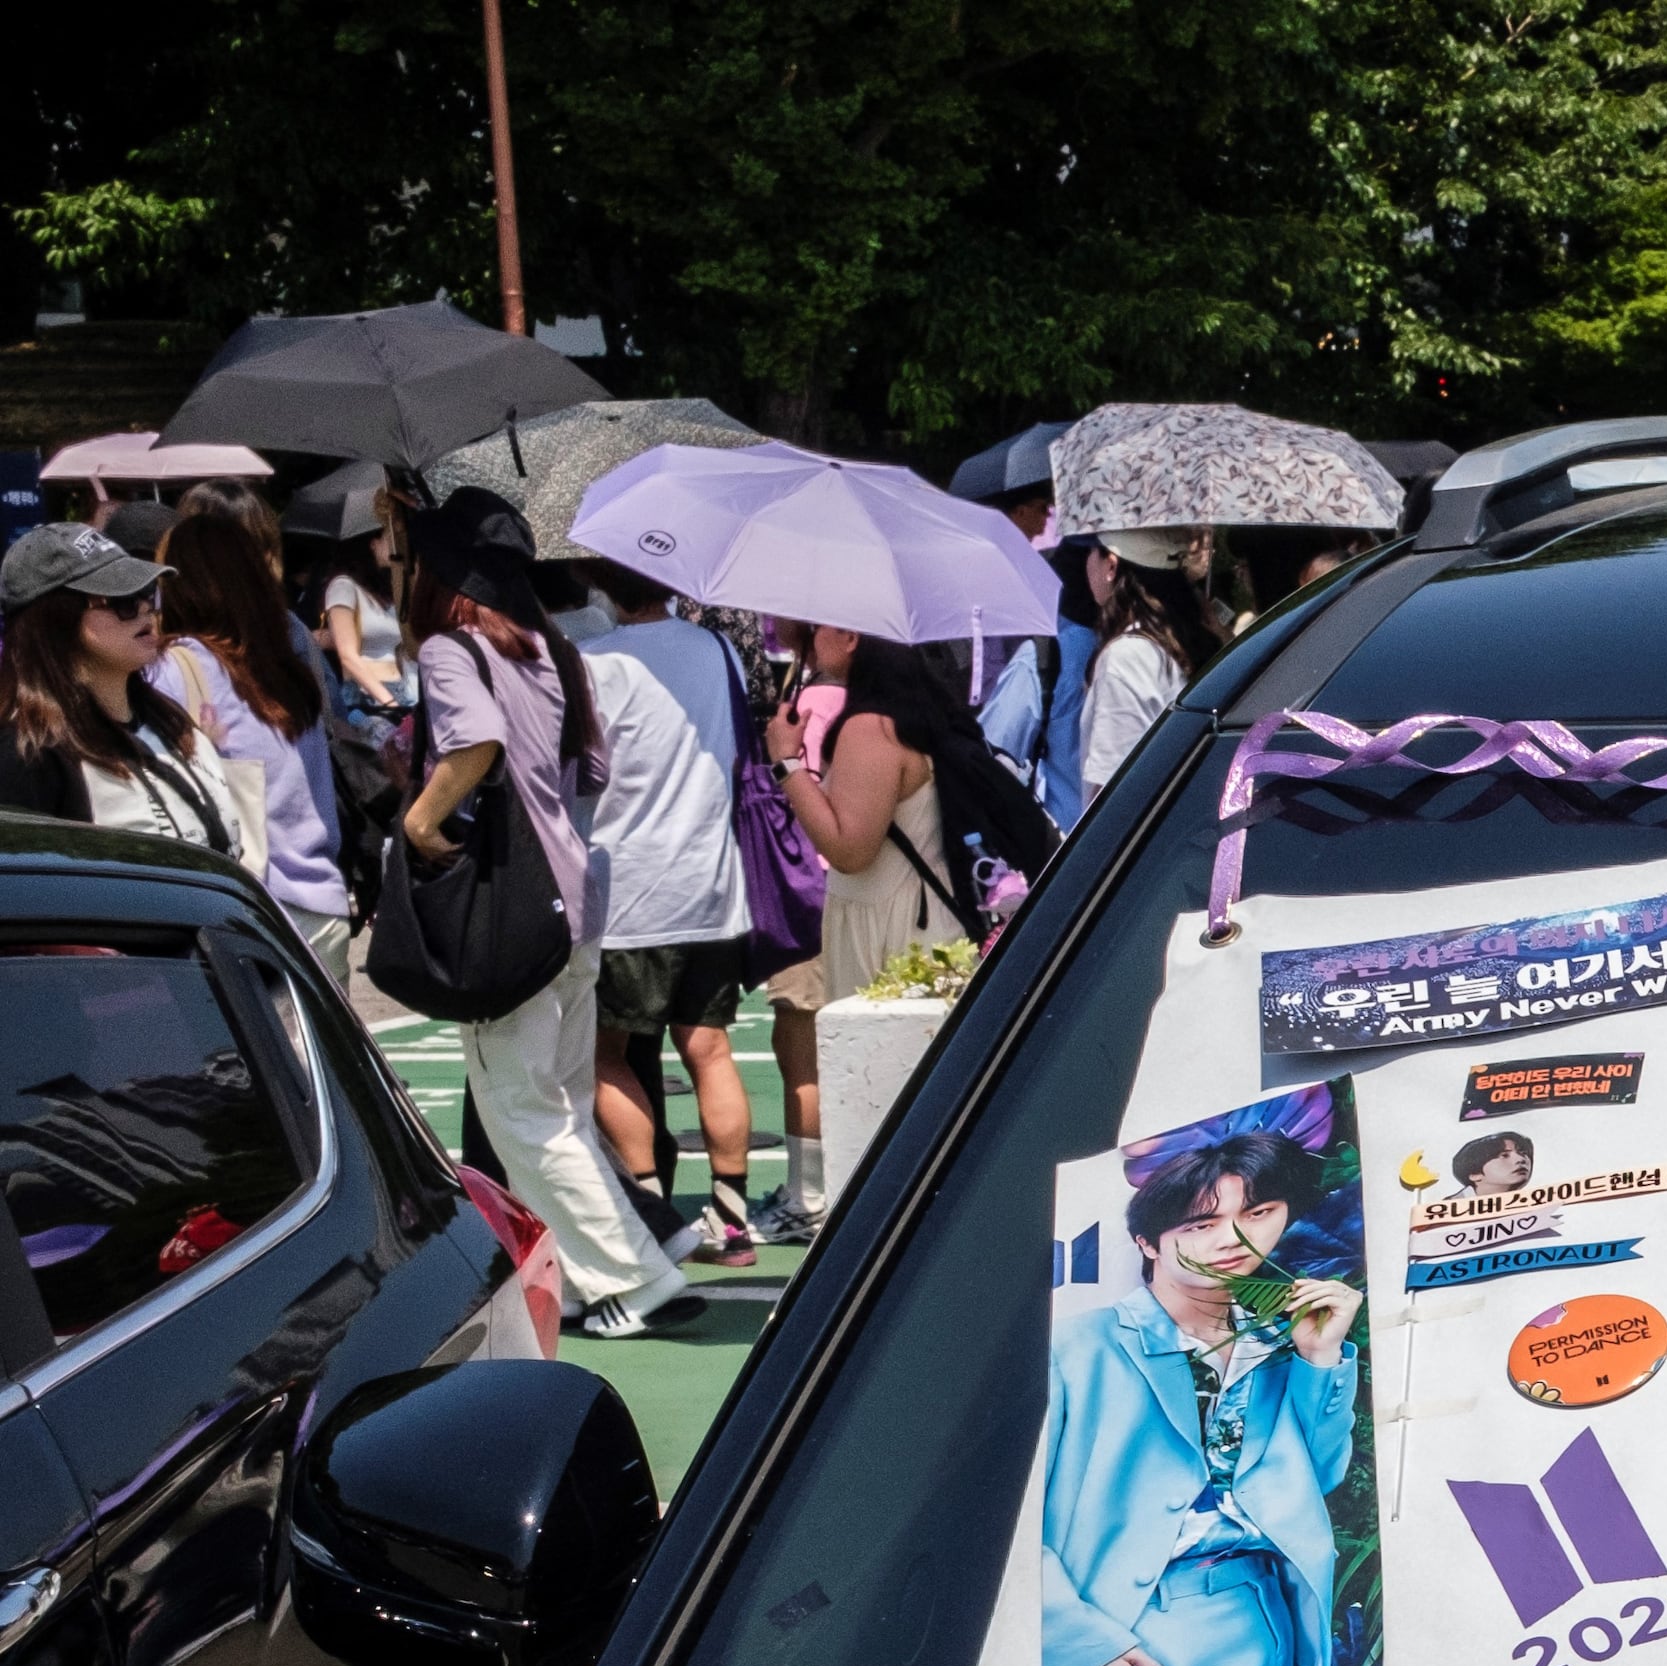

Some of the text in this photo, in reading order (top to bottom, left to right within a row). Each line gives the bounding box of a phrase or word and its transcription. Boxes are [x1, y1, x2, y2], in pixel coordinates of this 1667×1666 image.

[1444, 974, 1501, 1005] 늘
[1379, 1006, 1488, 1036] Army
[1499, 985, 1625, 1021] Never
[1475, 1063, 1634, 1091] 당연히도 우리 사이
[1531, 1084, 1550, 1099] 안
[1468, 1219, 1516, 1245] JIN
[1426, 1241, 1626, 1283] ASTRONAUT
[1528, 1315, 1650, 1355] PERMISSION
[1532, 1329, 1652, 1367] TO DANCE
